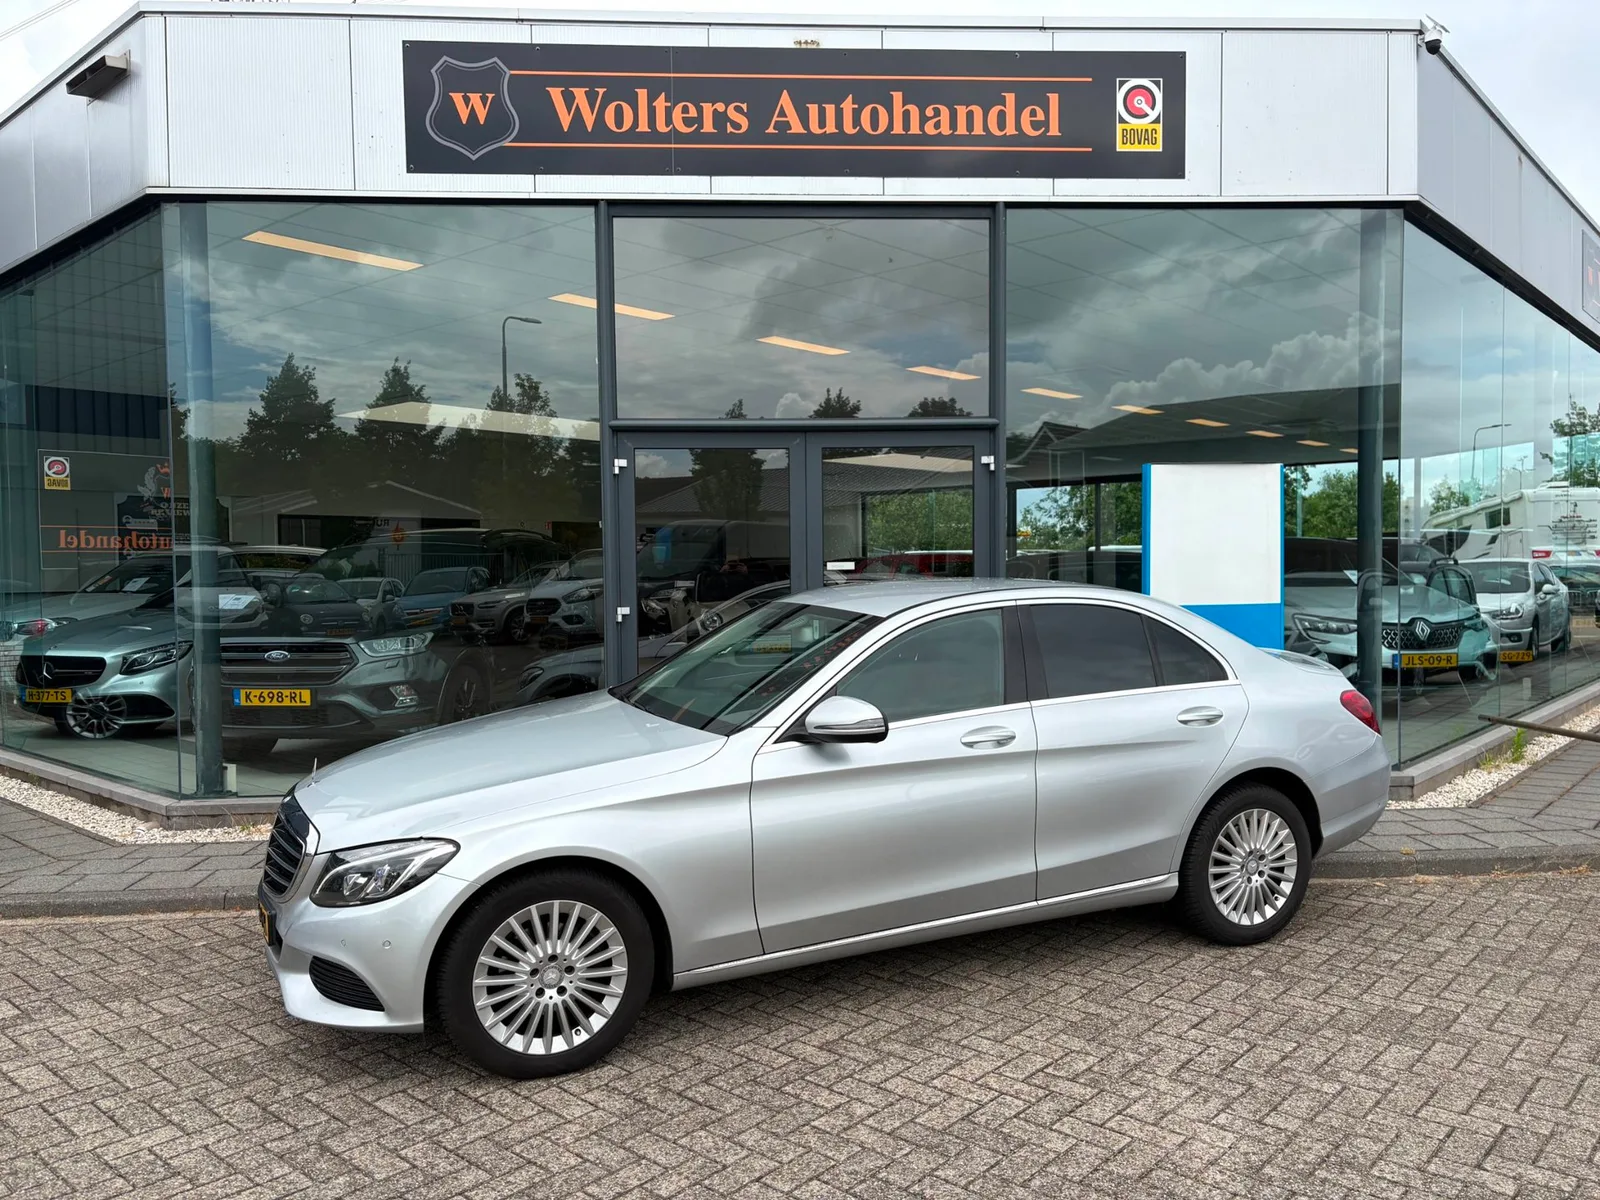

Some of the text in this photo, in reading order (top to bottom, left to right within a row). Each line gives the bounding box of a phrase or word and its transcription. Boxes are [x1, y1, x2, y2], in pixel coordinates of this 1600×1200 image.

[449, 92, 495, 125] W
[546, 86, 1062, 137] Wolters Autohandel
[1121, 128, 1158, 146] BOVAG
[1405, 654, 1453, 666] JLS-09-R
[28, 690, 67, 701] H-377-TS
[245, 691, 307, 704] K-698-RL
